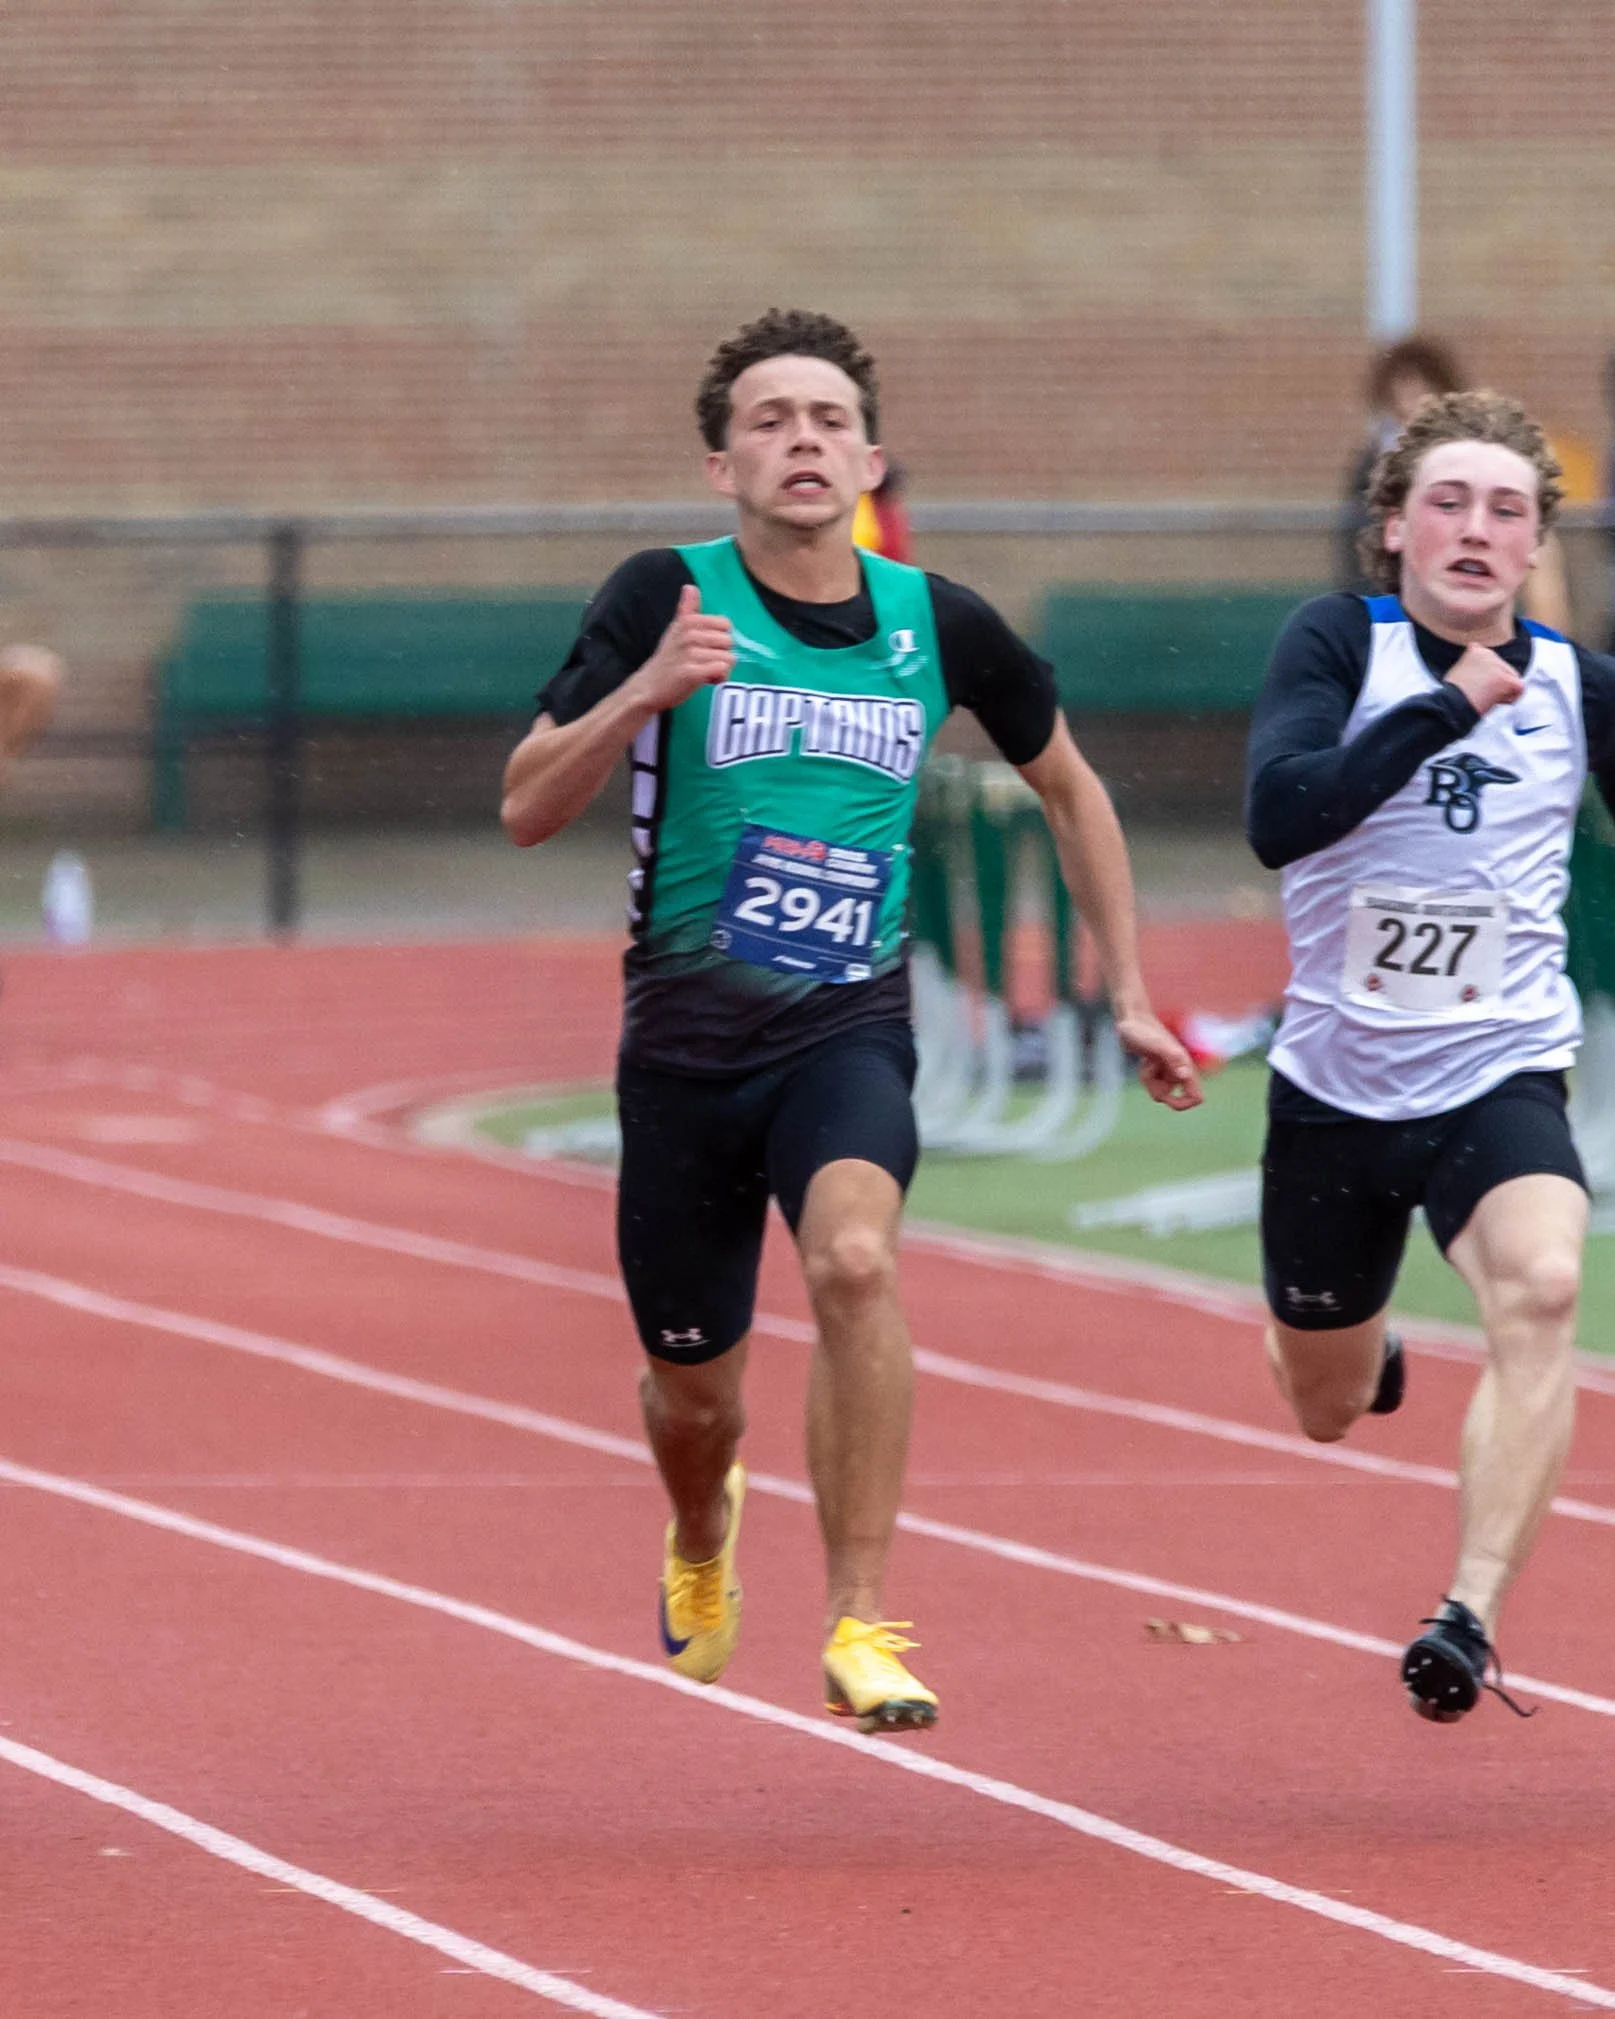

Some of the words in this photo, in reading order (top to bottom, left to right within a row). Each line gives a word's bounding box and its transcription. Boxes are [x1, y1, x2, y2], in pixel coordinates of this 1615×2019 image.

[707, 682, 926, 785] CAPTAINS
[733, 876, 874, 946] 2941
[1374, 917, 1480, 977] 227
